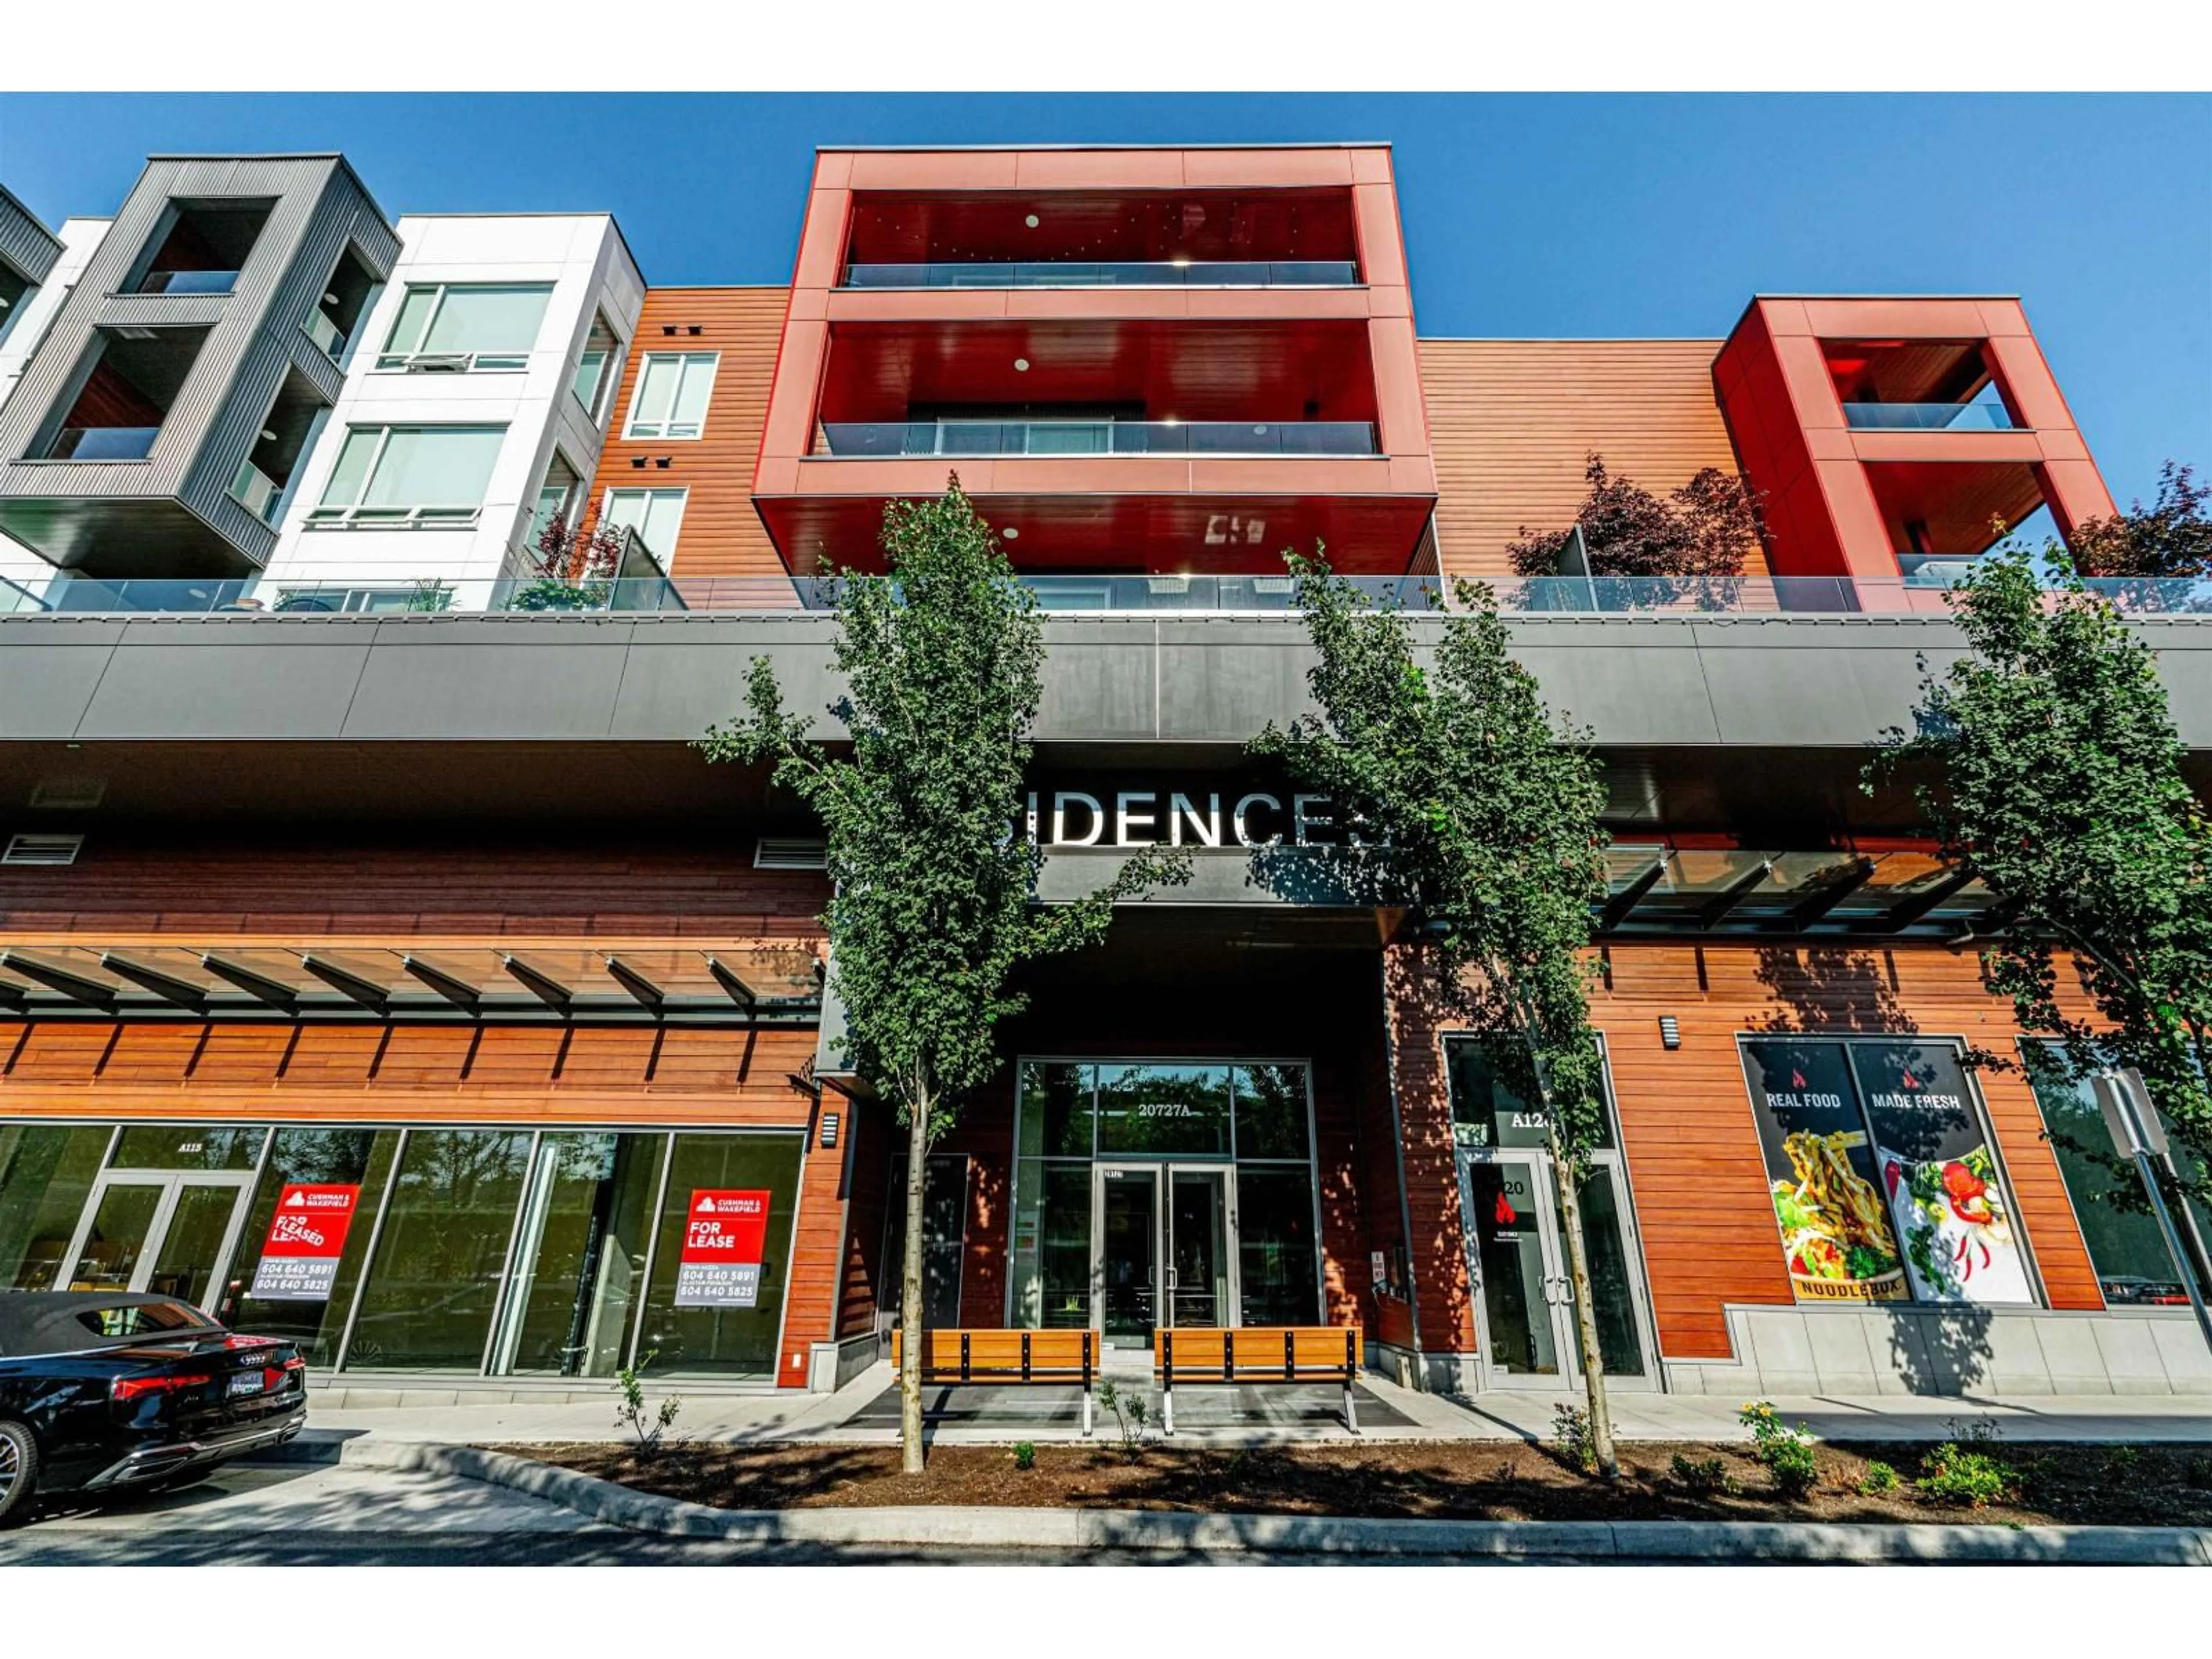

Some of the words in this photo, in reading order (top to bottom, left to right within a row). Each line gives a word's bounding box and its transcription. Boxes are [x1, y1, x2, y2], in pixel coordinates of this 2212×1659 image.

[1766, 1093, 1801, 1107] REAL
[1805, 1094, 1841, 1108] FOOD
[1872, 1093, 1912, 1108] MADE
[1915, 1094, 1960, 1108] FRESH
[1139, 1104, 1191, 1116] 20727A
[1512, 1113, 1550, 1128] A12
[281, 1219, 324, 1247] LEASED
[690, 1222, 721, 1234] FOR
[688, 1235, 736, 1248] LEASE
[262, 1264, 283, 1274] 604
[285, 1264, 305, 1274] 640
[308, 1264, 332, 1275] 5891
[683, 1270, 703, 1280] 604
[707, 1271, 728, 1281] 640
[730, 1271, 754, 1281] 5891
[257, 1279, 277, 1289] 604
[279, 1279, 301, 1290] 640
[302, 1280, 328, 1290] 5825
[1801, 1281, 1899, 1297] NOODLEBOX
[680, 1286, 700, 1296] 604
[704, 1286, 725, 1296] 640
[728, 1287, 753, 1297] 5825
